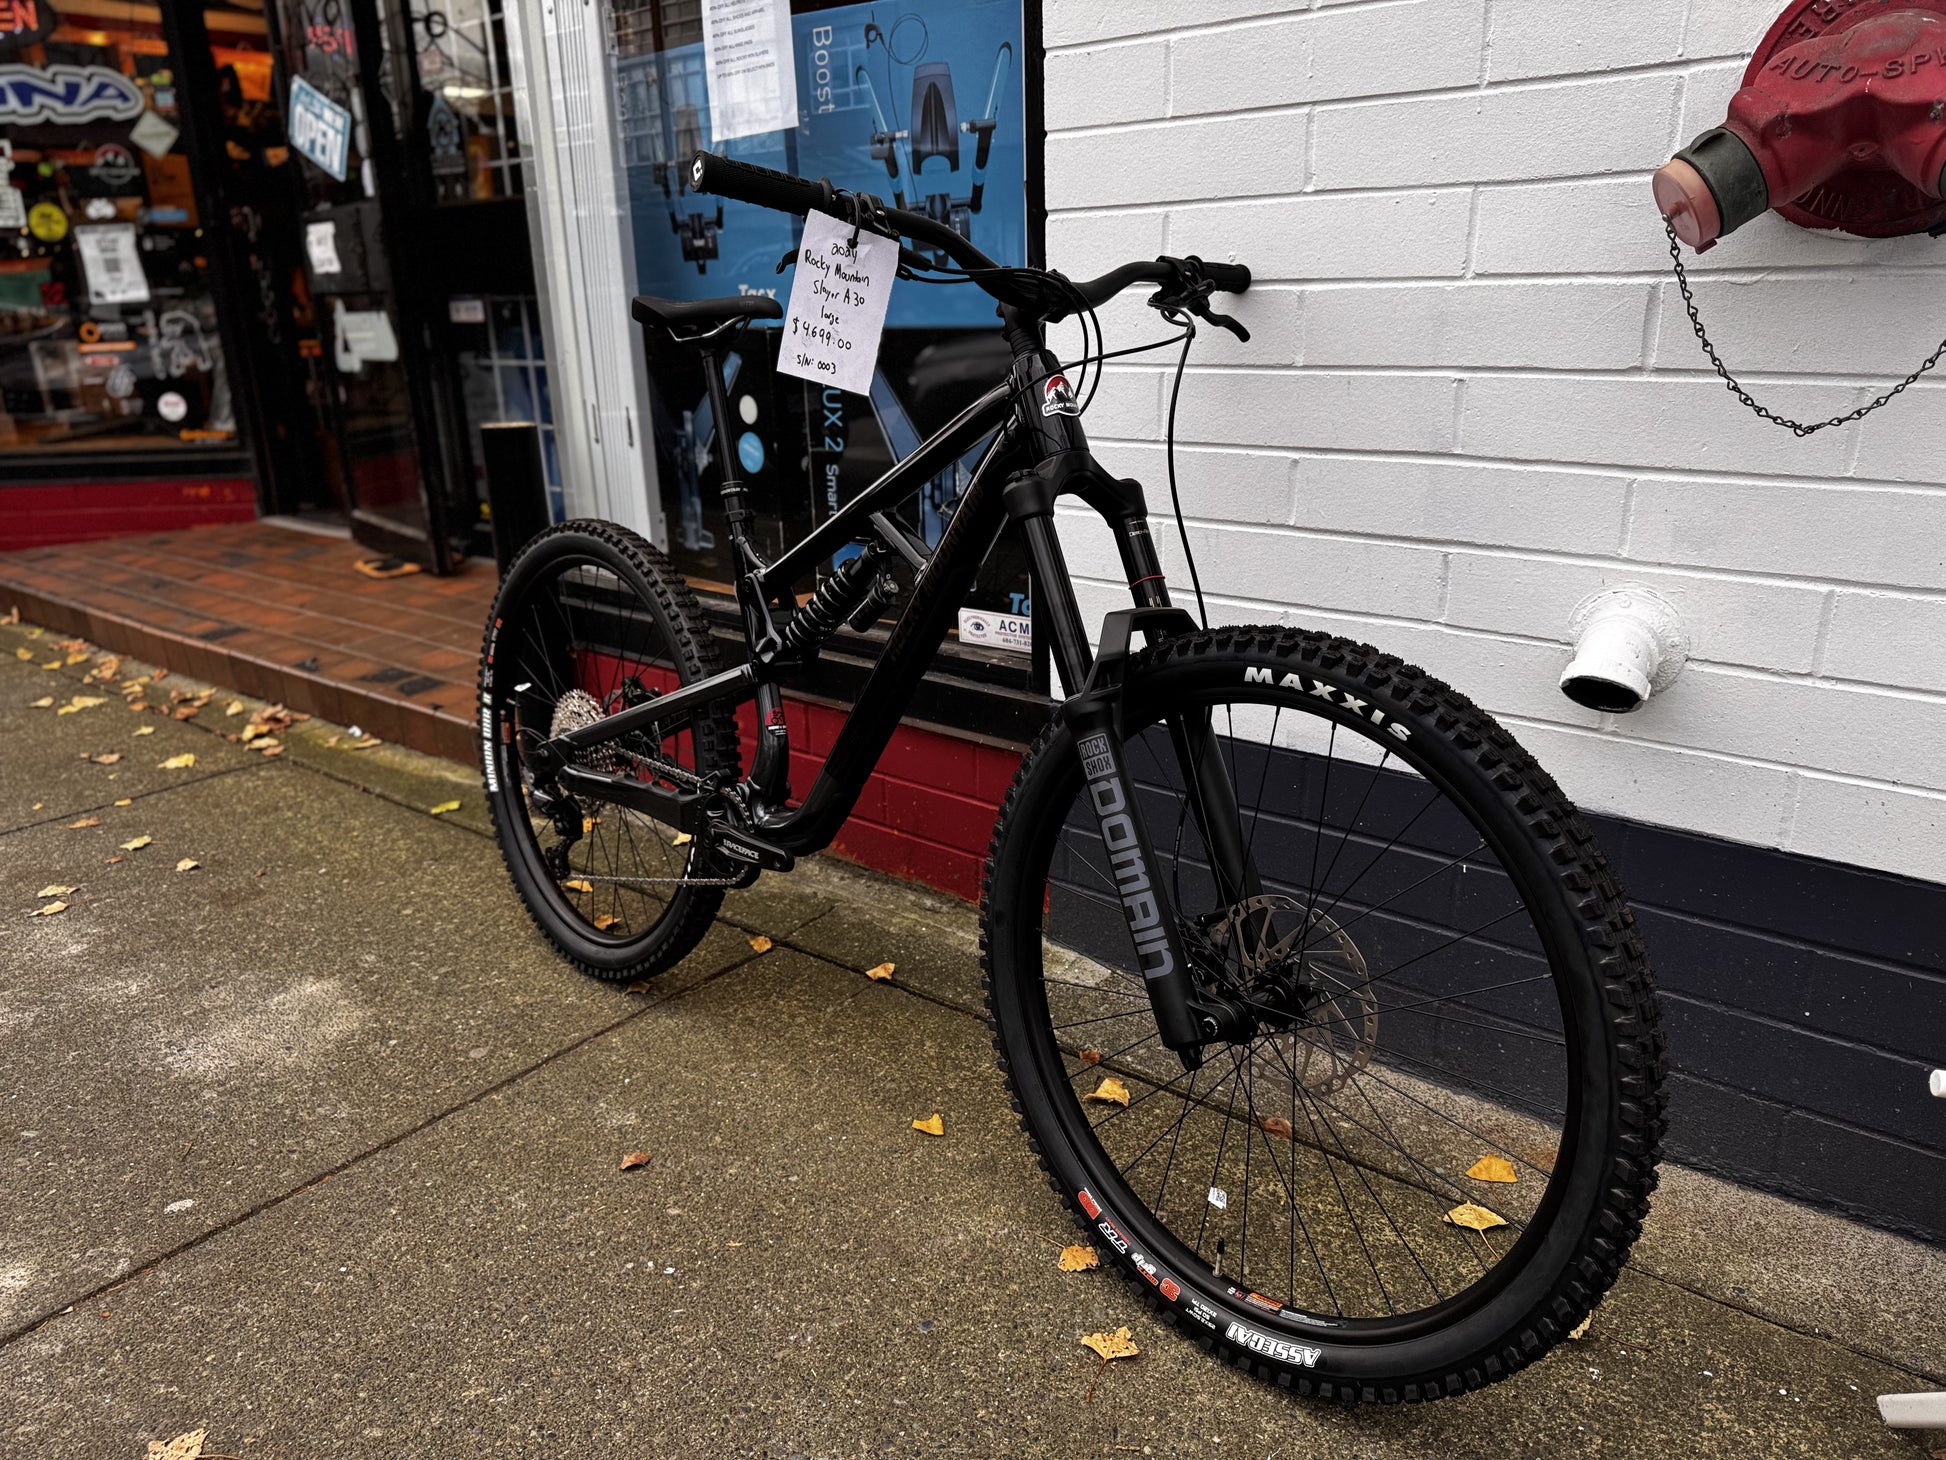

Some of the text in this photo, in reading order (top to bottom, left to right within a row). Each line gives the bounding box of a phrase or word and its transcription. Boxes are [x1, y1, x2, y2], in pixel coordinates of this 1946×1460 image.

[813, 26, 836, 114] Boost
[295, 103, 344, 173] OPEN
[804, 249, 870, 287] Rocky Mountain
[820, 305, 840, 325] large
[796, 353, 836, 375] S/N: 0003
[824, 436, 845, 453] 2
[826, 464, 840, 516] Smart
[1243, 666, 1412, 742] MAXXIS
[483, 741, 499, 792] MINION
[1080, 735, 1108, 758] ROCK
[1085, 754, 1113, 777] SHOX
[1090, 777, 1174, 980] DOMAIN
[1225, 1320, 1322, 1368] ASSEGAI
